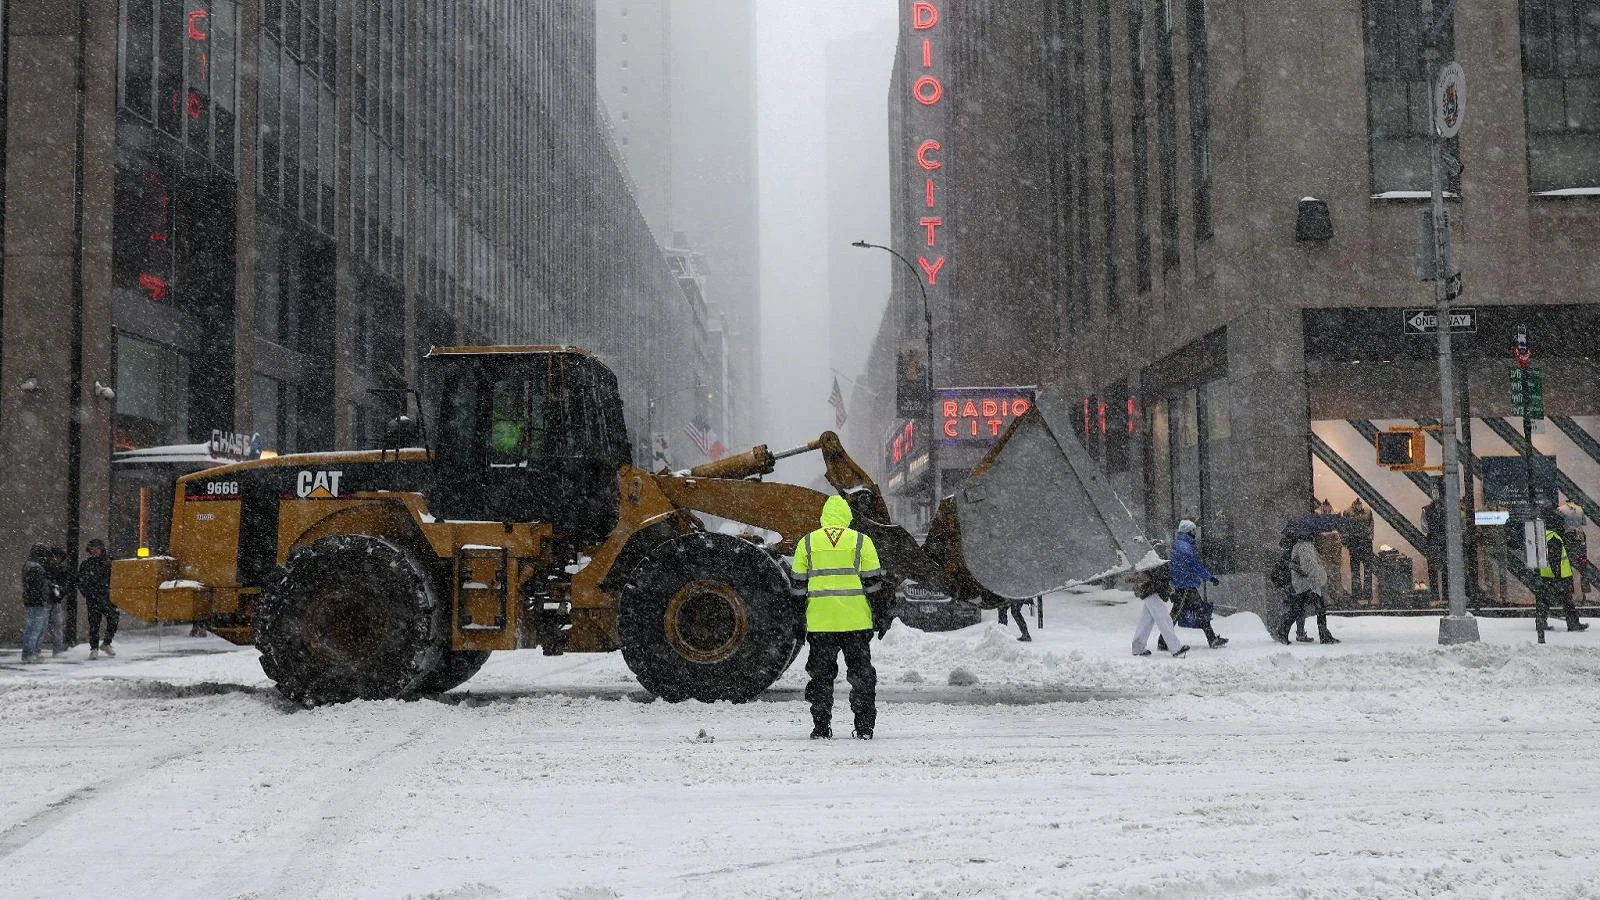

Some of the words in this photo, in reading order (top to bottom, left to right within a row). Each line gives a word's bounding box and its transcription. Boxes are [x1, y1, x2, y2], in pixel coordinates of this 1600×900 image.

[917, 140, 945, 286] CITY
[1415, 316, 1436, 326] ONE
[943, 399, 1029, 417] RADIO
[944, 419, 1002, 437] CIT
[212, 429, 250, 456] CHASE
[207, 481, 238, 495] 966G
[297, 471, 342, 498] CAT
